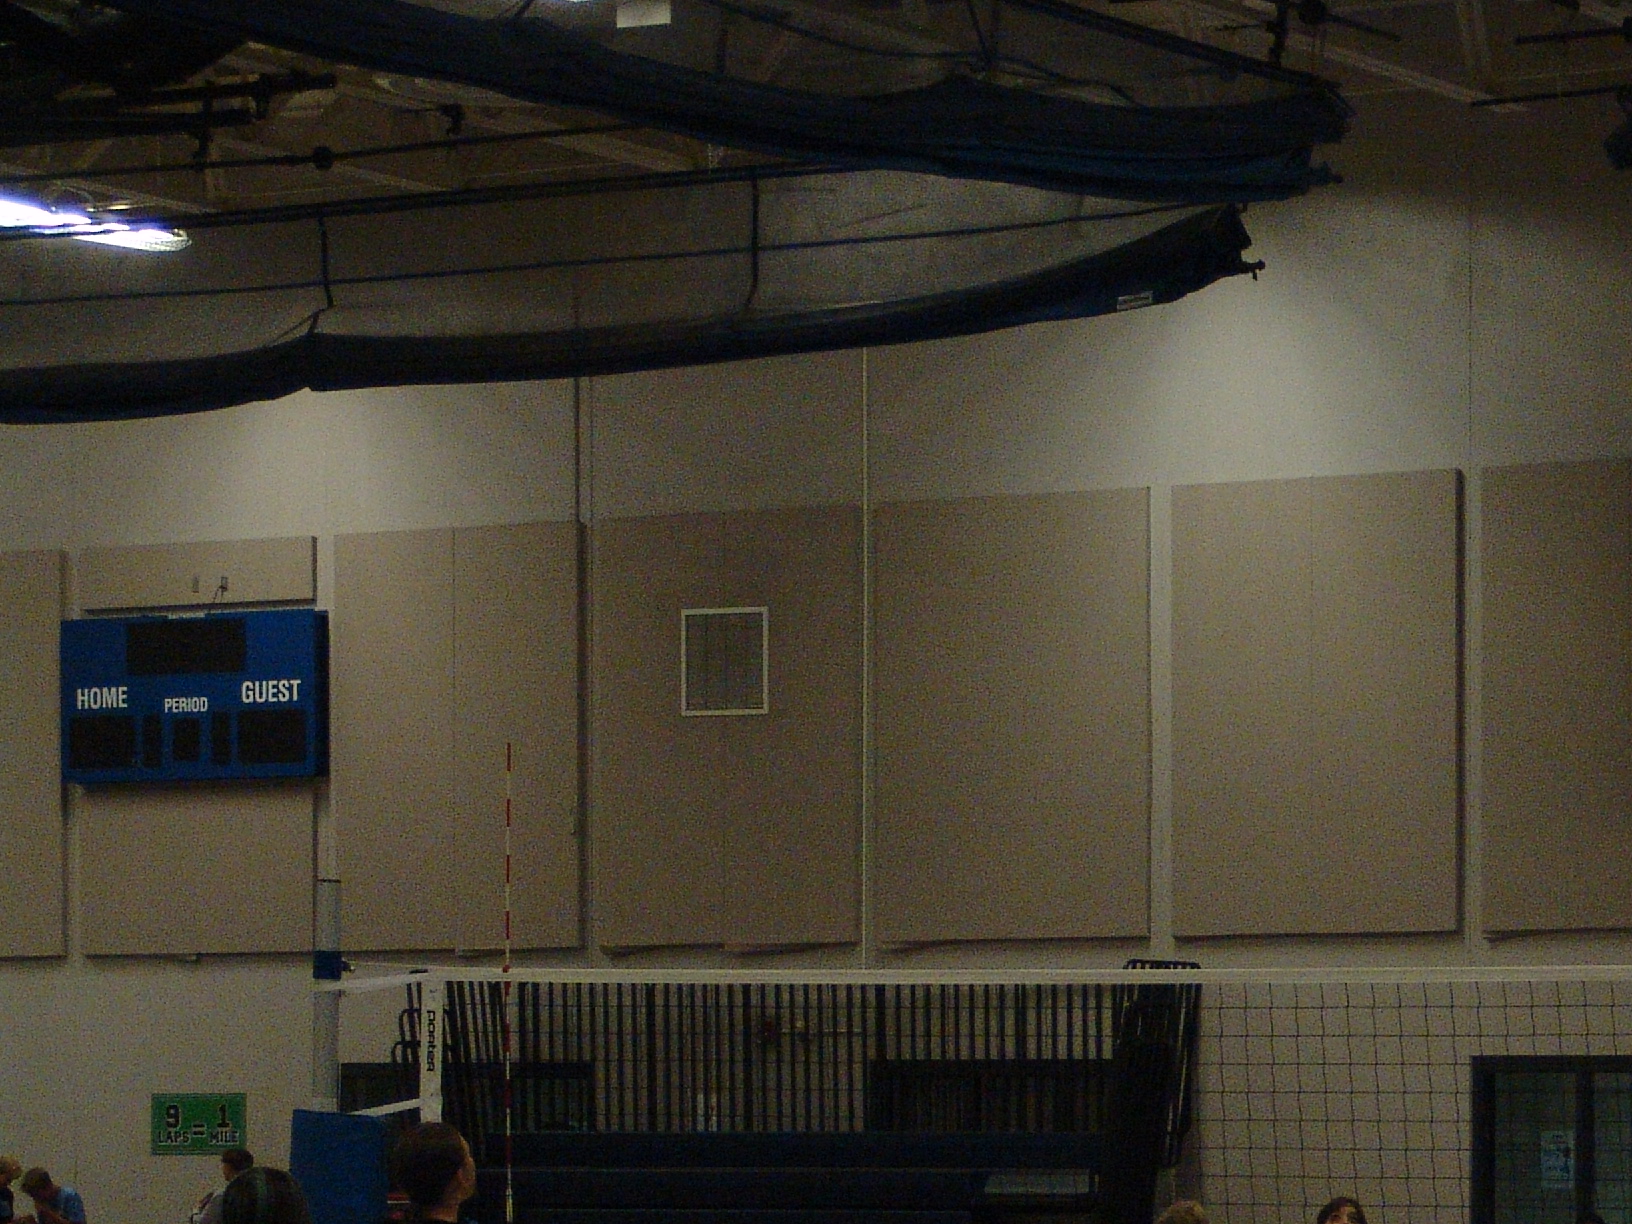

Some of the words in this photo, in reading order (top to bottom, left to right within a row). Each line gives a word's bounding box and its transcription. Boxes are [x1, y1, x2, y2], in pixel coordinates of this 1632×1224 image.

[77, 686, 128, 710] HOME
[241, 679, 301, 704] GUEST
[164, 697, 208, 713] PERIOD
[165, 1103, 181, 1129] 9
[216, 1103, 231, 1128] 1
[158, 1130, 191, 1144] LAPS
[209, 1130, 239, 1144] MILE
